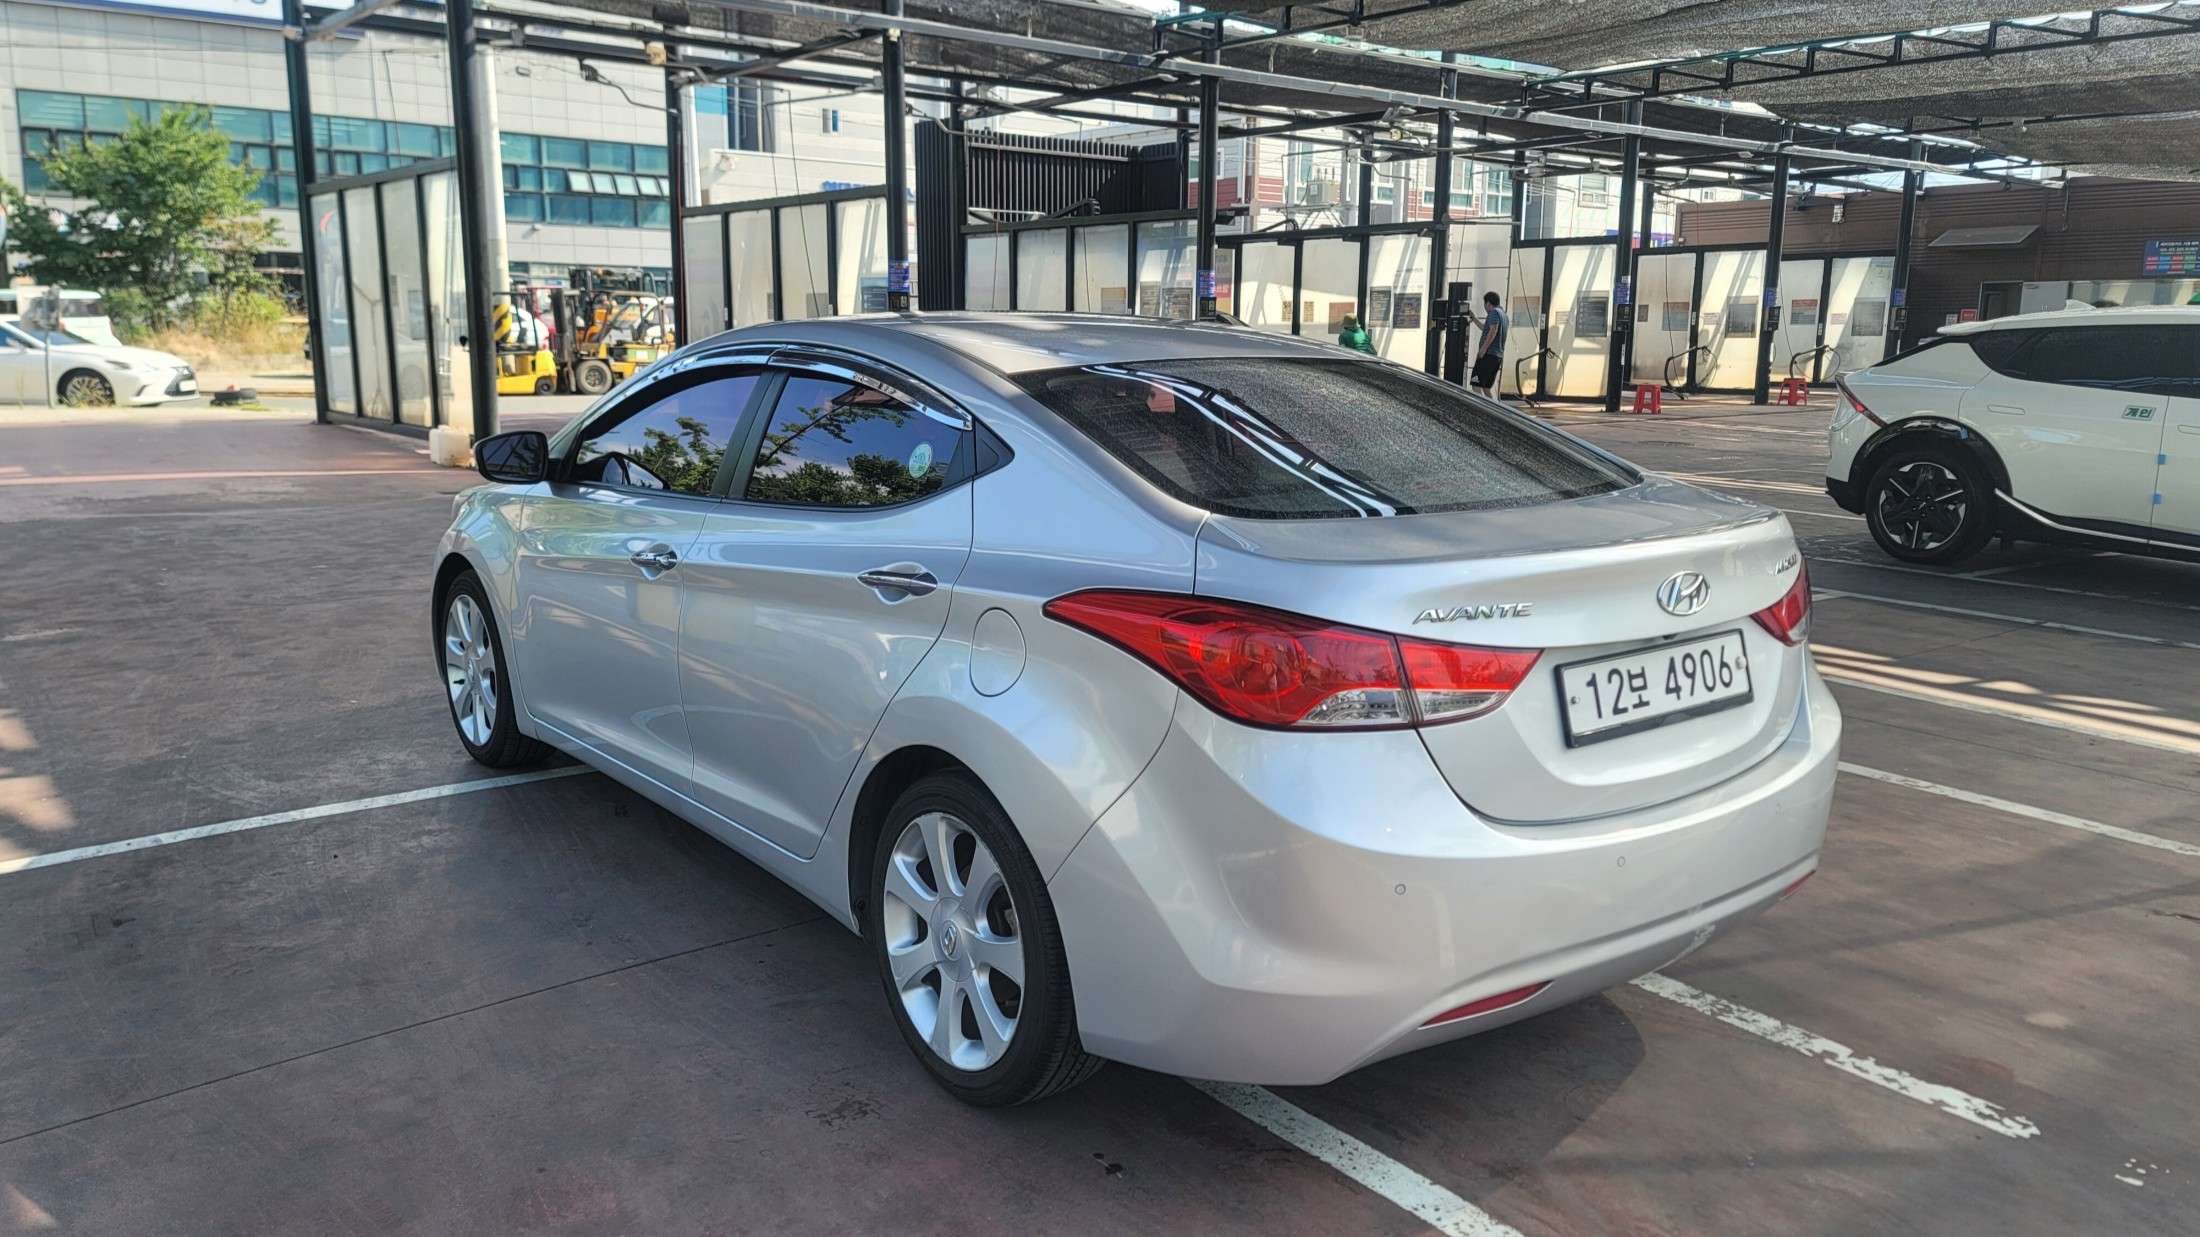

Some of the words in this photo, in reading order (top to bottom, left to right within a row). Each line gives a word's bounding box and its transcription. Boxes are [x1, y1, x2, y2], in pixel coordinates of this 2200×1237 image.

[2124, 407, 2152, 418] 개인
[1412, 602, 1534, 625] AVANTE
[1586, 666, 1650, 719] 12보
[1665, 645, 1733, 701] 4906
